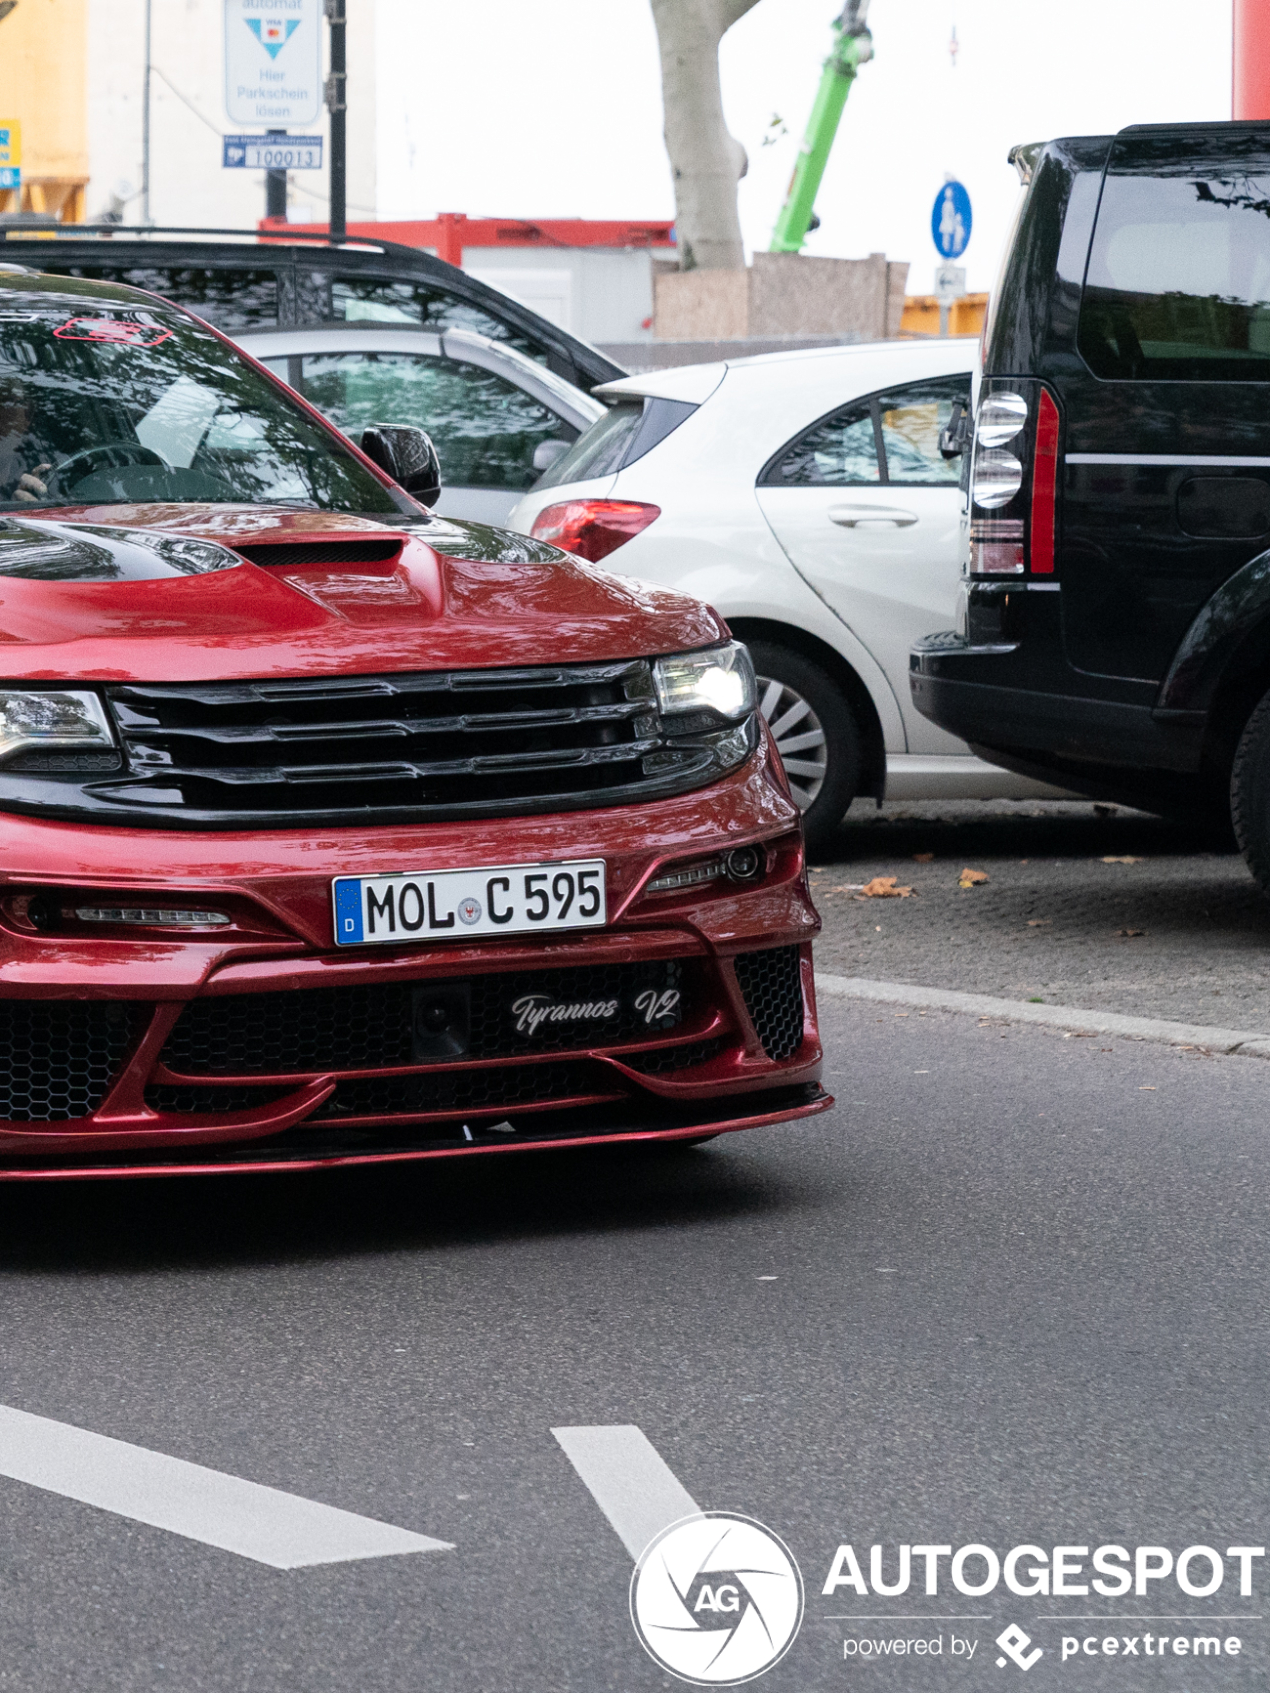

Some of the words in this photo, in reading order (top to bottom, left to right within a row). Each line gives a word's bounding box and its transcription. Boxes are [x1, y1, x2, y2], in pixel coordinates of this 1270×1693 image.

[259, 69, 285, 81] Hier
[237, 86, 308, 99] Parkschein
[255, 104, 291, 116] lösen
[256, 150, 313, 167] 100013
[344, 918, 355, 932] D
[366, 882, 455, 934] MOL
[487, 876, 514, 924] C
[524, 869, 601, 922] 595
[512, 994, 619, 1035] Tyrannos
[634, 989, 680, 1024] V2
